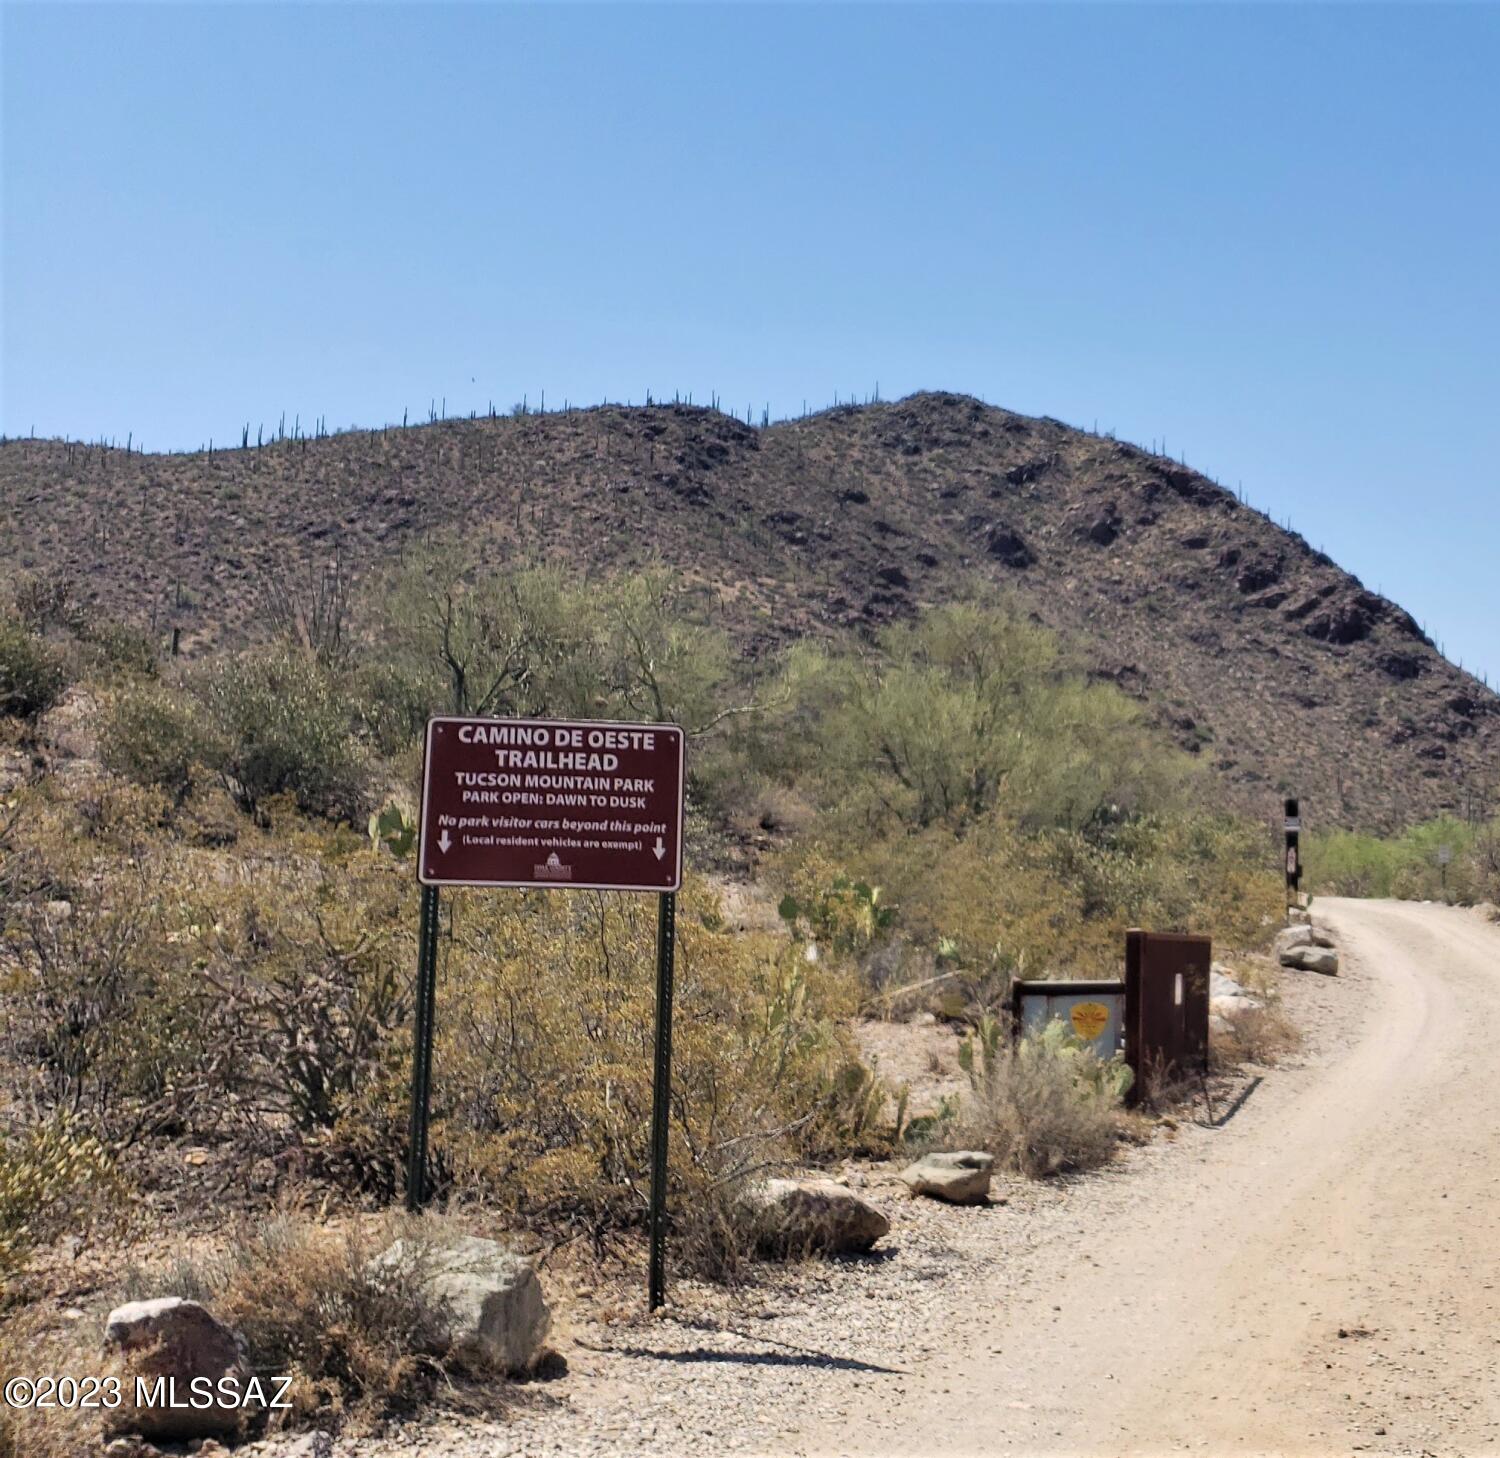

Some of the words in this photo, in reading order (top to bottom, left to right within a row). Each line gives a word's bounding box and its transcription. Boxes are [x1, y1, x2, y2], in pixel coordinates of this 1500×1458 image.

[458, 725, 550, 746] CAMINO
[555, 729, 583, 748] DE
[588, 730, 655, 751] OESTE
[495, 749, 619, 771] TRAILHEAD
[454, 771, 521, 787] TUCSON
[525, 774, 610, 790] MOUNTAIN
[614, 777, 655, 792] PARK
[462, 790, 499, 804] PARK
[502, 792, 543, 805] OPEN:
[546, 793, 587, 806] DAWN
[589, 795, 607, 807] TO
[610, 795, 646, 809] DUSK
[438, 814, 456, 826] No
[458, 815, 489, 829] park
[492, 816, 532, 828] visitor
[534, 819, 560, 829] cars
[562, 817, 608, 833] beyond
[609, 819, 632, 833] this
[633, 822, 667, 835] point
[462, 834, 494, 846] (Local
[495, 835, 539, 846] resident
[540, 836, 581, 847] vehicles
[583, 840, 600, 848] are
[601, 840, 642, 851] exempt)
